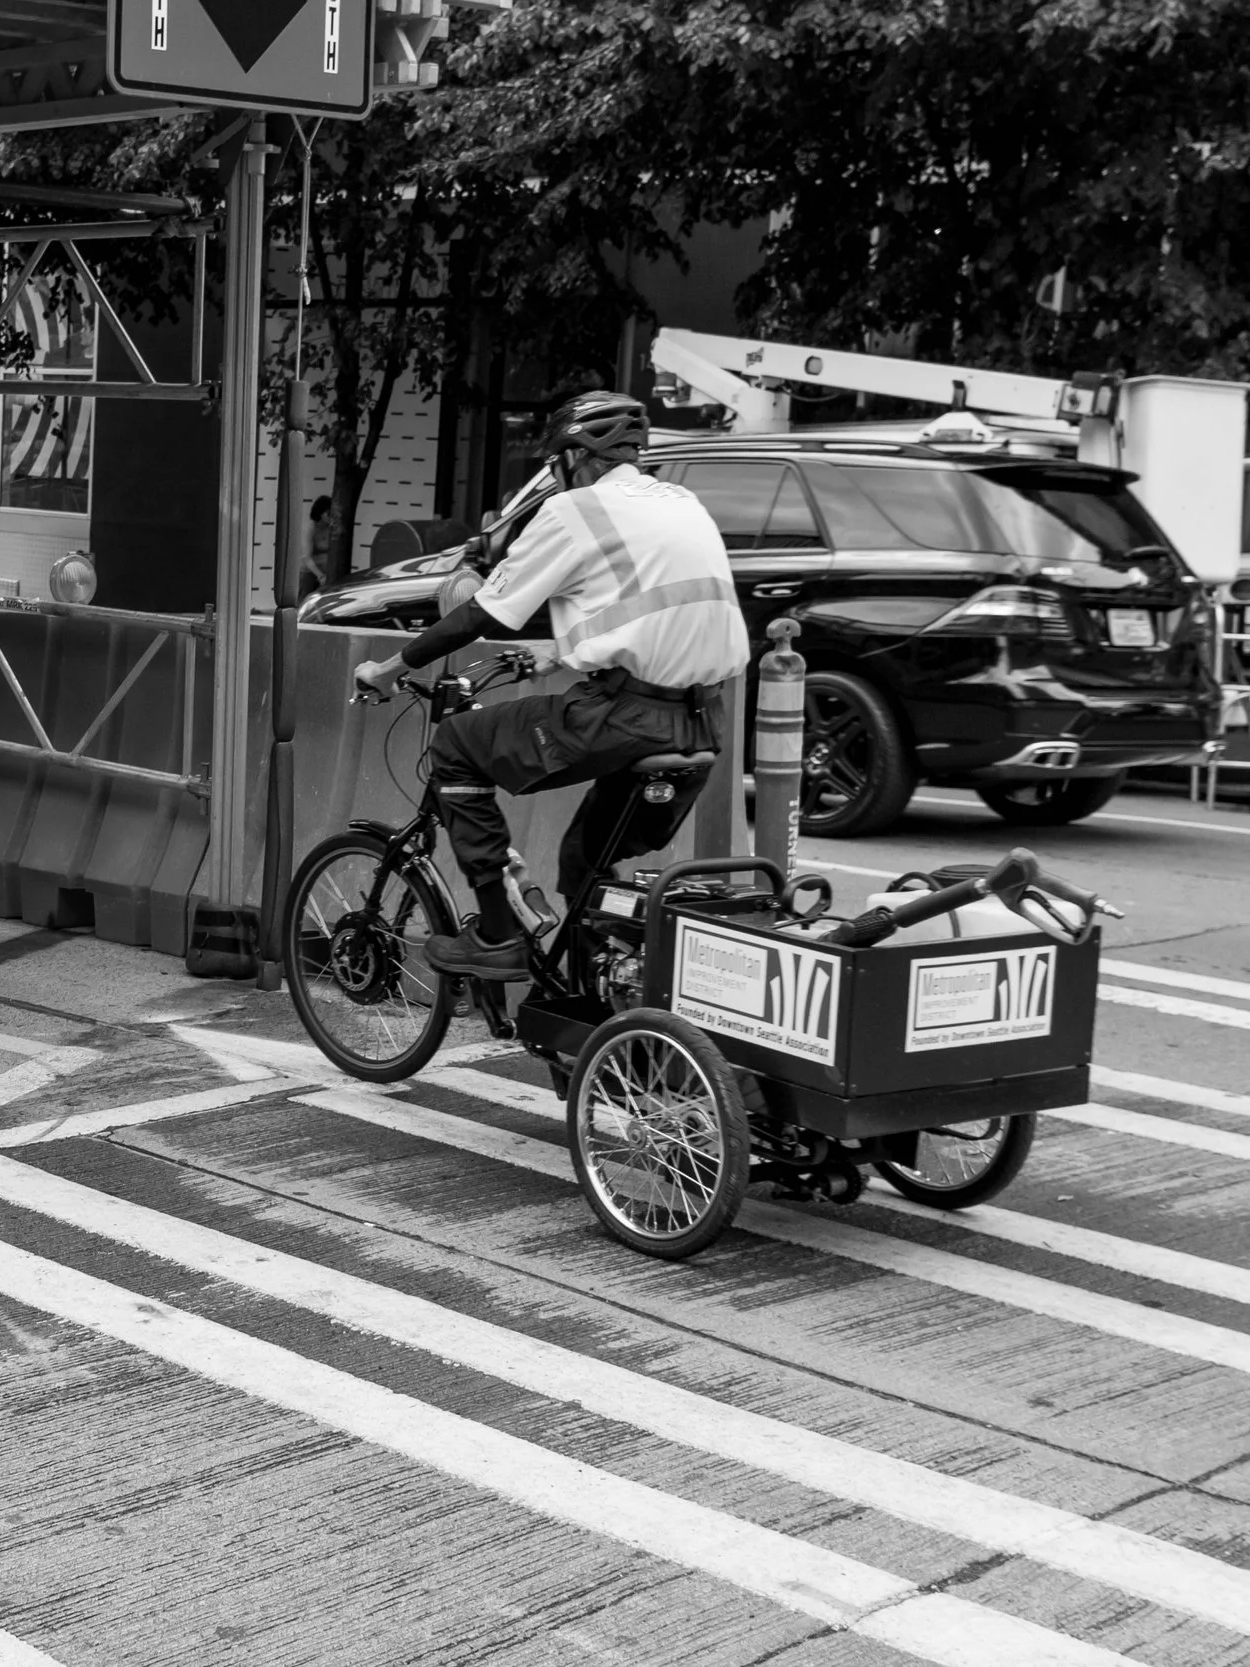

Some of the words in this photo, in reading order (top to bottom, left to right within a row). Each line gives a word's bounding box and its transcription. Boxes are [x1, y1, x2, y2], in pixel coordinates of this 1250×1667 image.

[687, 936, 761, 981] Metropolitan
[685, 967, 747, 993] IMPROVEMENT
[922, 968, 992, 997] Metropolitan
[676, 1003, 706, 1021] Founded
[707, 1010, 716, 1026] by
[717, 1014, 755, 1036] Downtown
[756, 1026, 783, 1045] Seattle
[785, 1035, 830, 1058] Association
